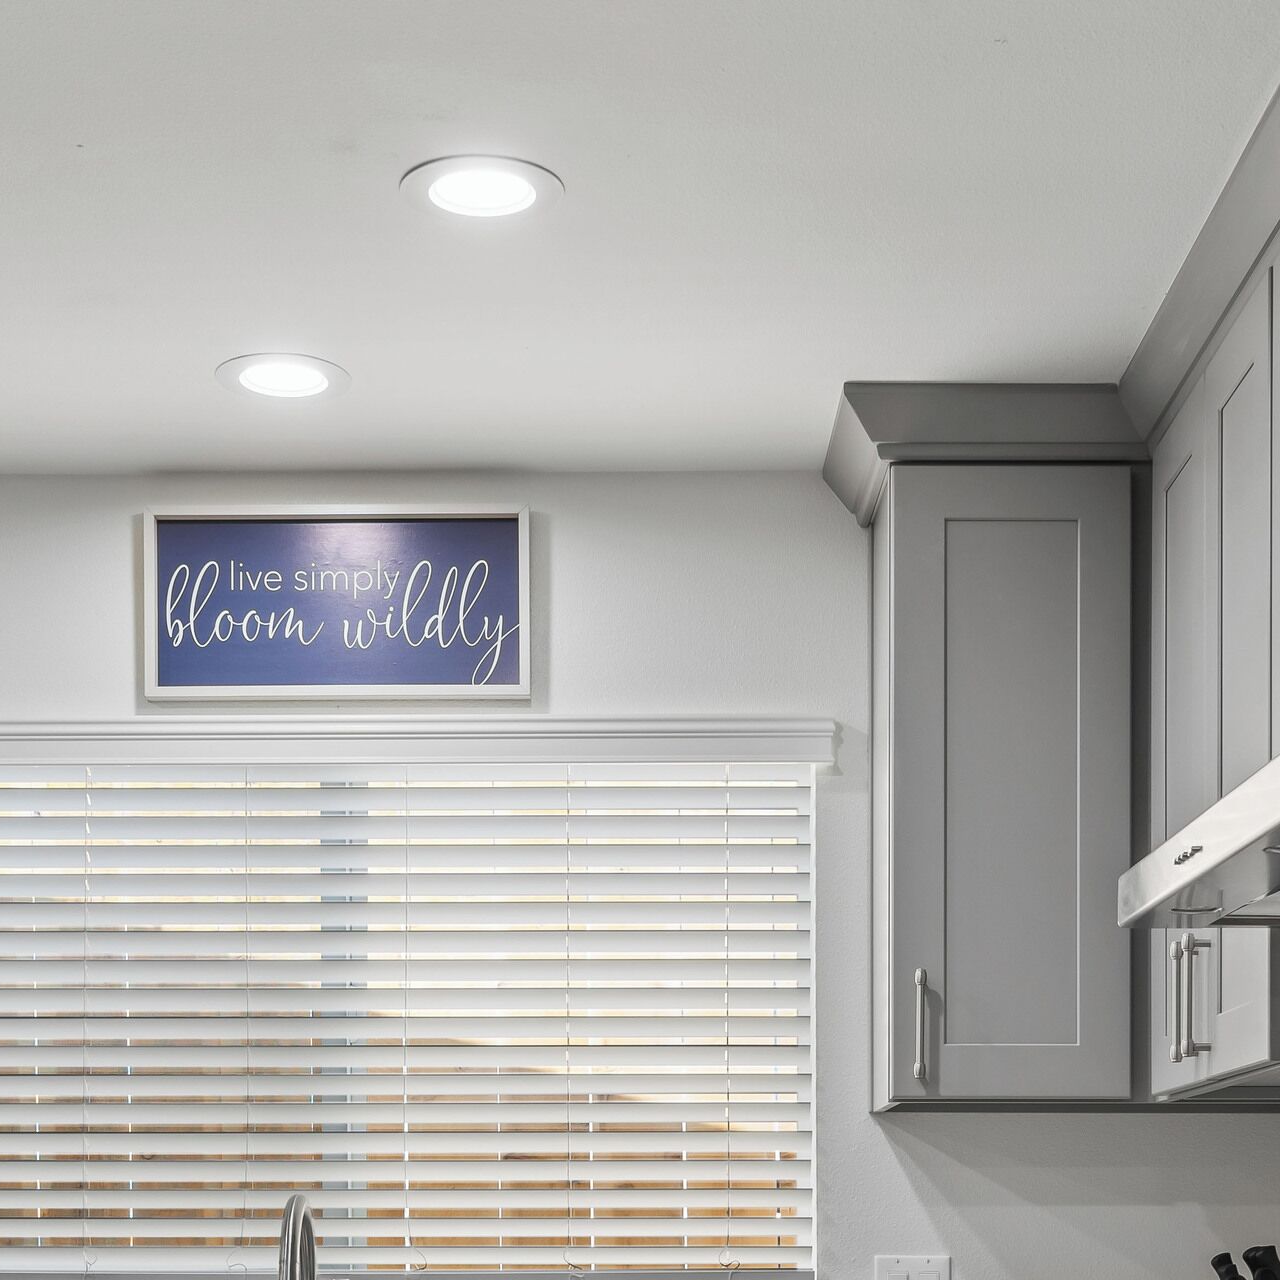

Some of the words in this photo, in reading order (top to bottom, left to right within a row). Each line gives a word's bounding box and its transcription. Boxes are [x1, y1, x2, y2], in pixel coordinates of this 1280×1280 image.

[229, 560, 282, 592] live
[294, 560, 400, 600] simply
[166, 561, 324, 648] bloom
[343, 560, 520, 686] wildly
